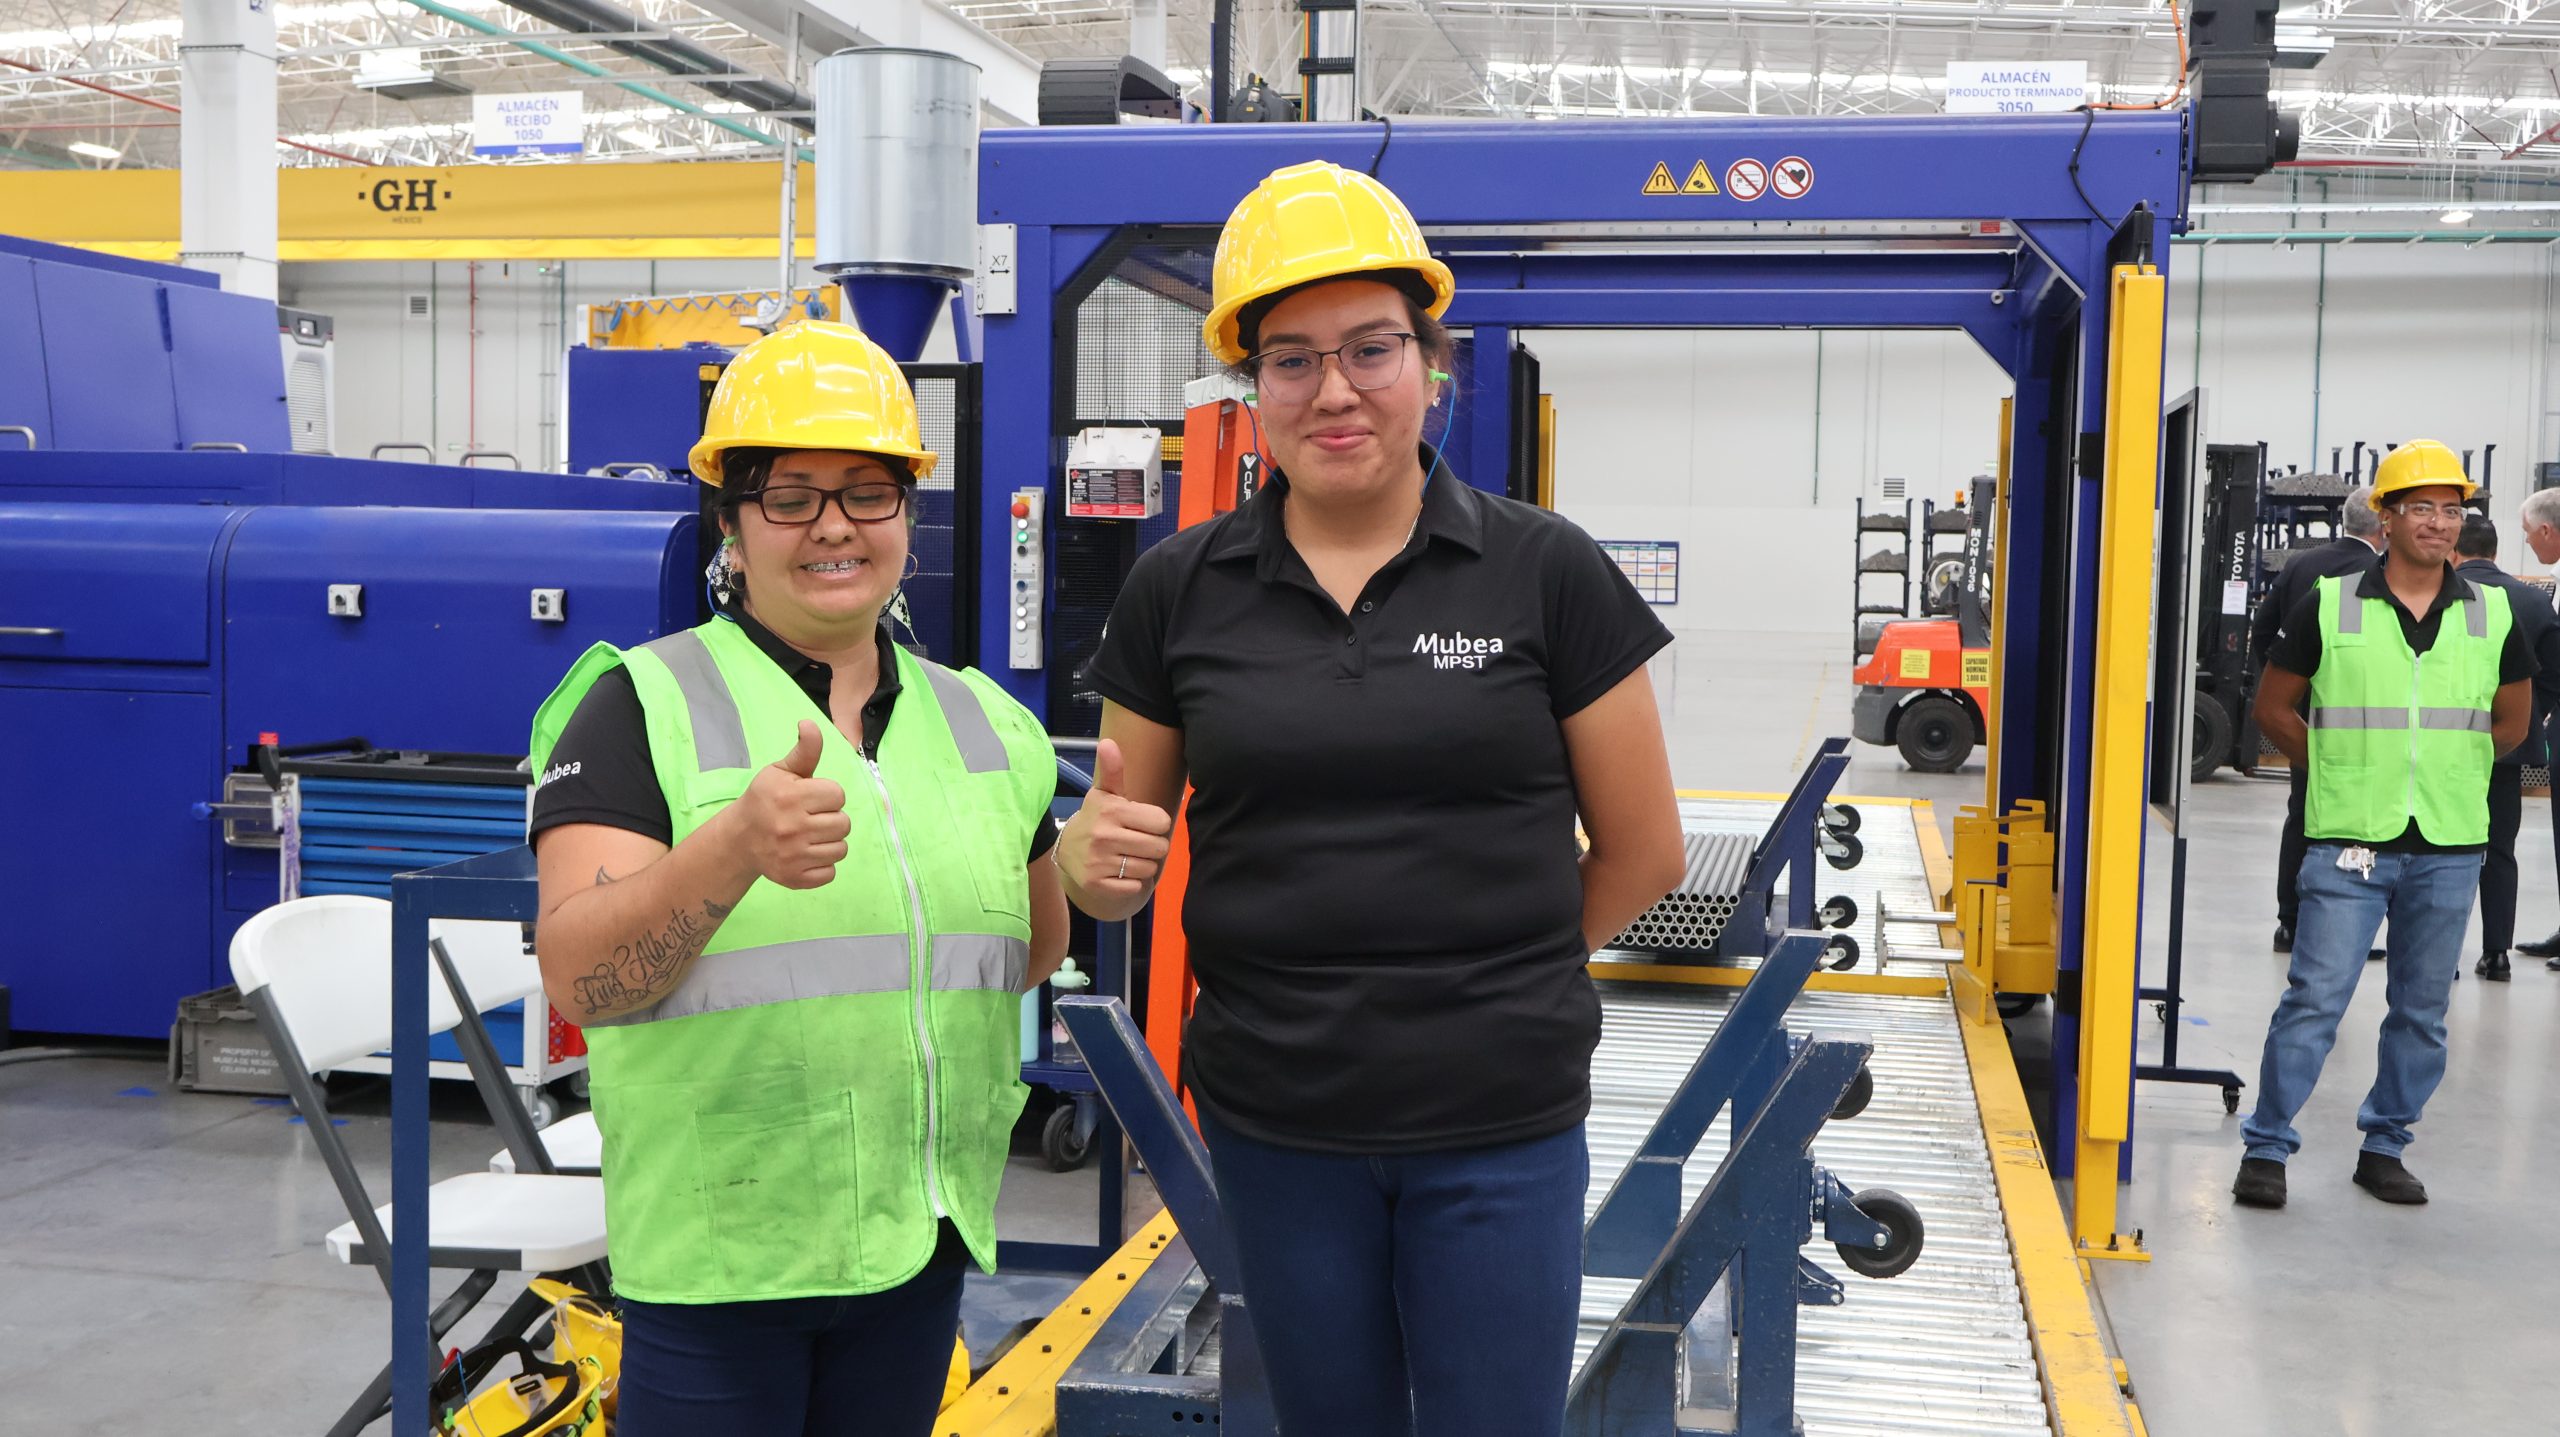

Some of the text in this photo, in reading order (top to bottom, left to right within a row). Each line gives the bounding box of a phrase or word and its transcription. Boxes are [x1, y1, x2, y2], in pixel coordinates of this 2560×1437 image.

[1981, 69, 2051, 83] ALMACÉN
[1949, 88, 2083, 97] PRODUCTO TERMINADO
[496, 97, 560, 113] ALMACÉN
[1996, 101, 2034, 112] 3050
[504, 114, 552, 127] RECIBO
[514, 128, 543, 141] 1050
[992, 254, 1008, 266] X7
[2231, 531, 2246, 581] TOYOTA
[1412, 631, 1504, 654] Mubea
[1433, 655, 1487, 669] MPST
